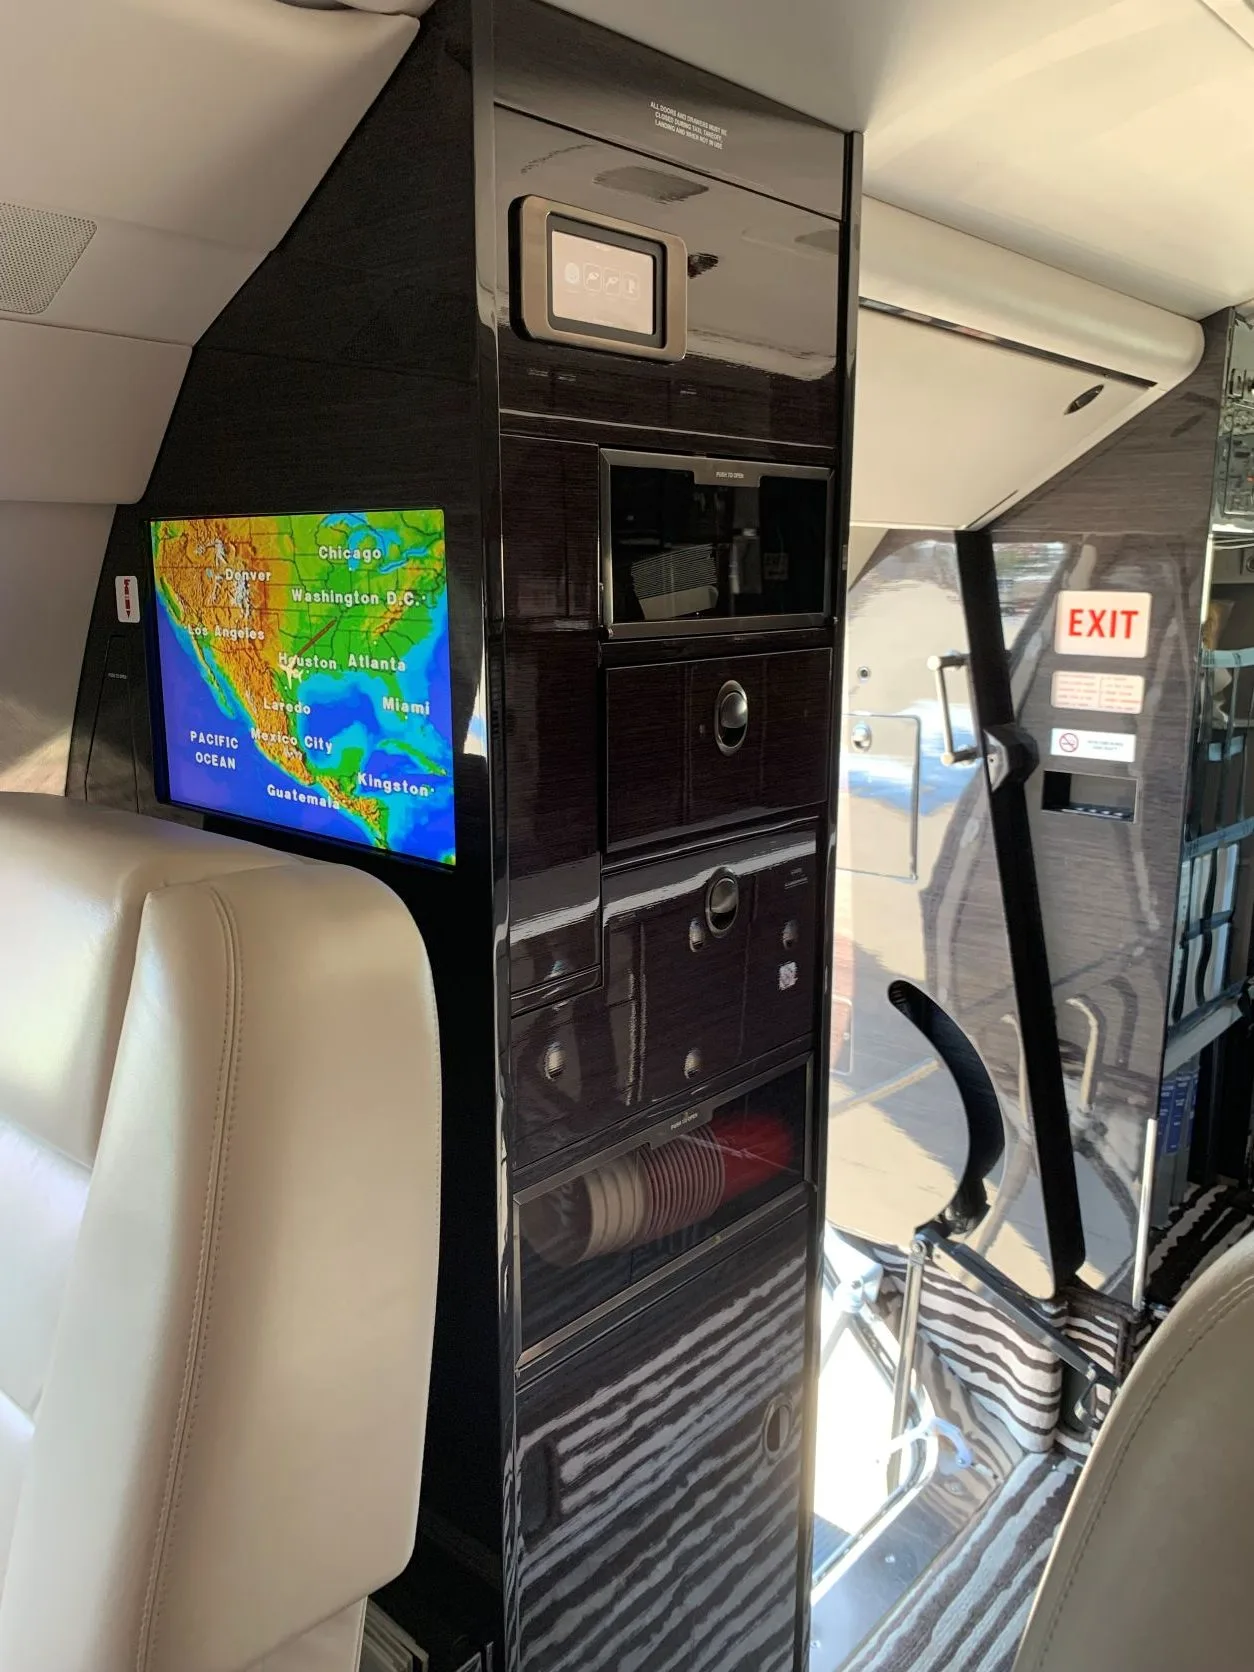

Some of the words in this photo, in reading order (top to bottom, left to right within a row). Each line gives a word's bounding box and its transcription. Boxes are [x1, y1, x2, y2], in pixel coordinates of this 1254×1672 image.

[318, 546, 382, 563] Chicago
[226, 568, 272, 582] Denver
[291, 588, 379, 606] Washington
[386, 591, 420, 606] D.C.
[188, 624, 208, 637] Los
[215, 625, 264, 641] Angeles
[1068, 608, 1139, 639] EXIT
[348, 653, 406, 672] Atlanta
[263, 698, 311, 715] Laredo
[382, 696, 430, 716] Miami
[190, 730, 238, 750] PACIFIC
[250, 728, 298, 746] Mexico
[304, 736, 332, 754] City
[196, 752, 236, 770] OCEAN
[357, 771, 430, 797] Kingston
[267, 784, 340, 810] Guatemala
